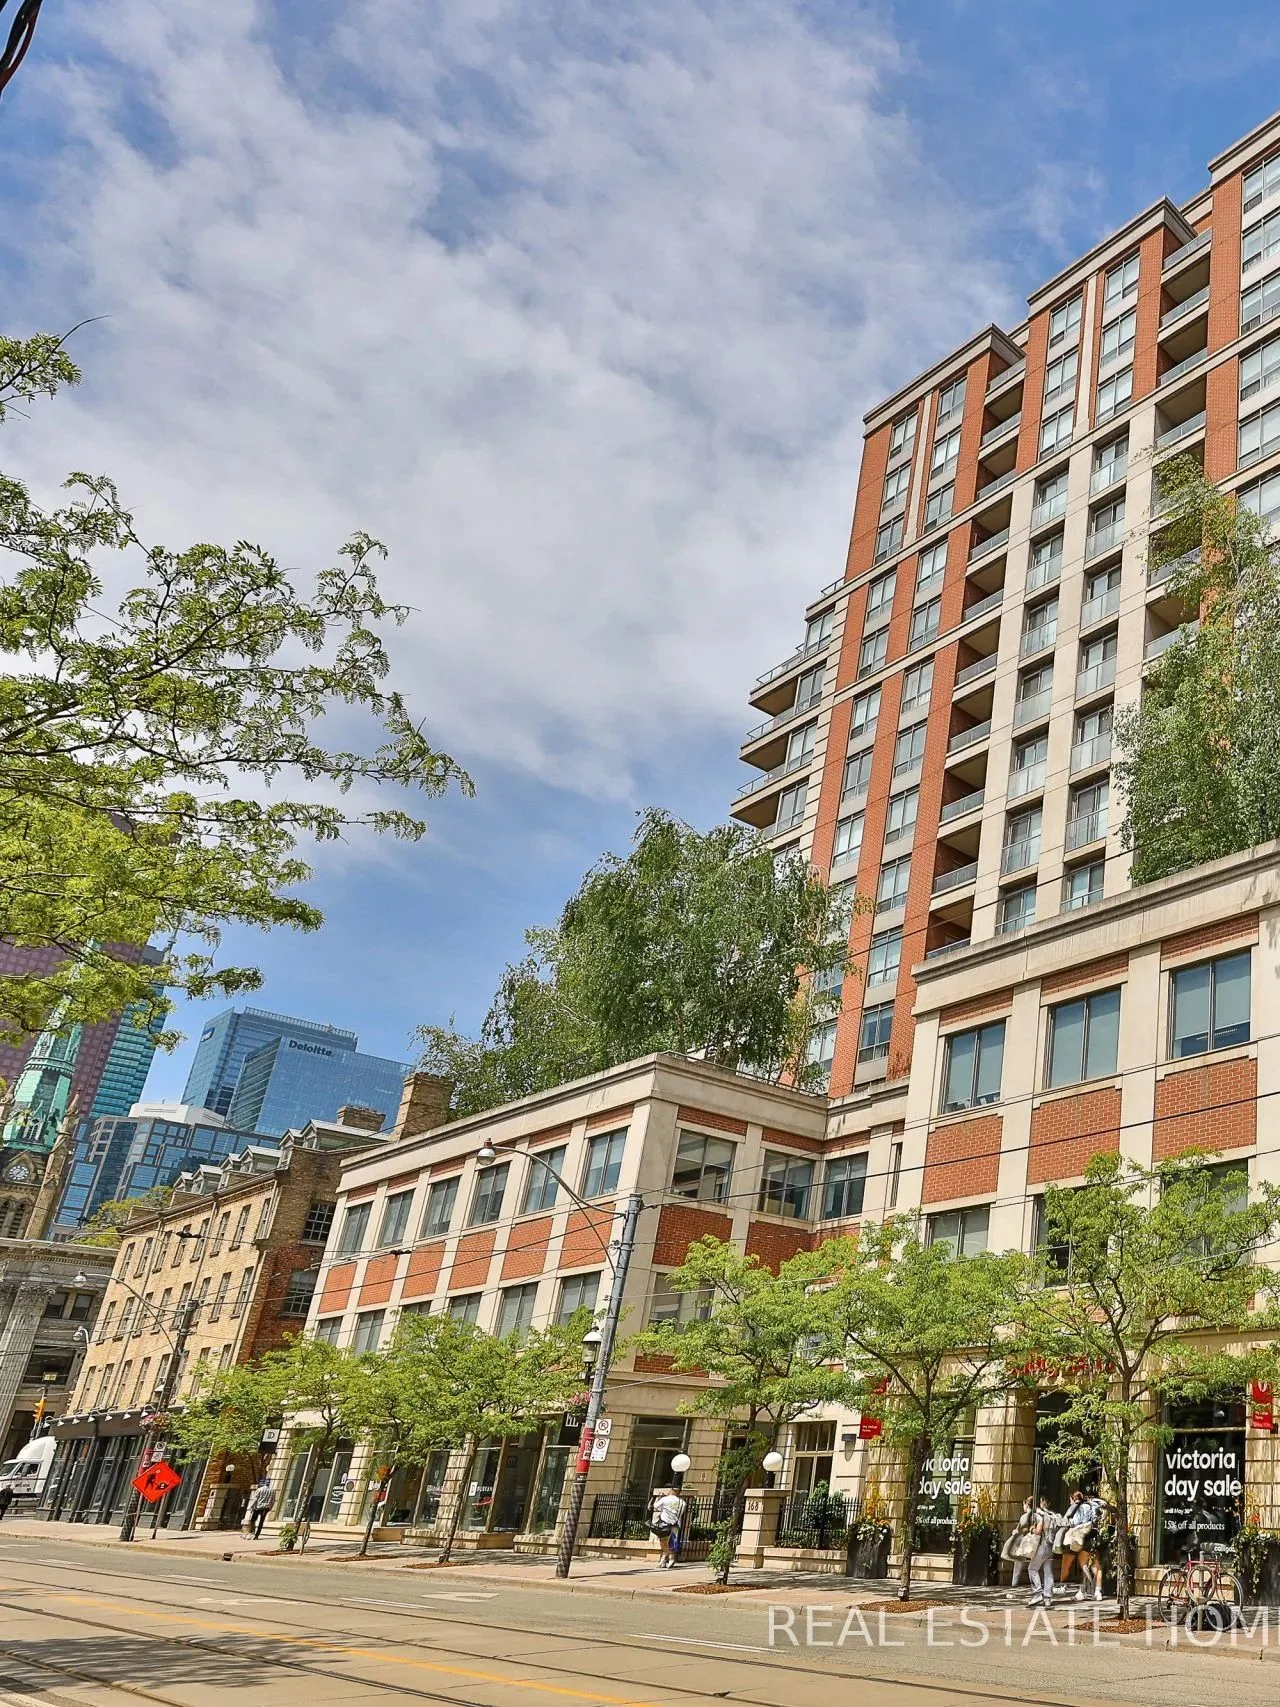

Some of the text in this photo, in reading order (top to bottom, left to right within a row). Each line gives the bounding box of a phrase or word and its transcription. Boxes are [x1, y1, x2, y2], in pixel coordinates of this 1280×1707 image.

[1165, 1447, 1236, 1470] victoria
[944, 1475, 972, 1495] sale
[1164, 1474, 1243, 1501] day sale
[747, 1501, 760, 1512] 168
[936, 1516, 958, 1527] products
[1164, 1520, 1226, 1533] 15% off all products
